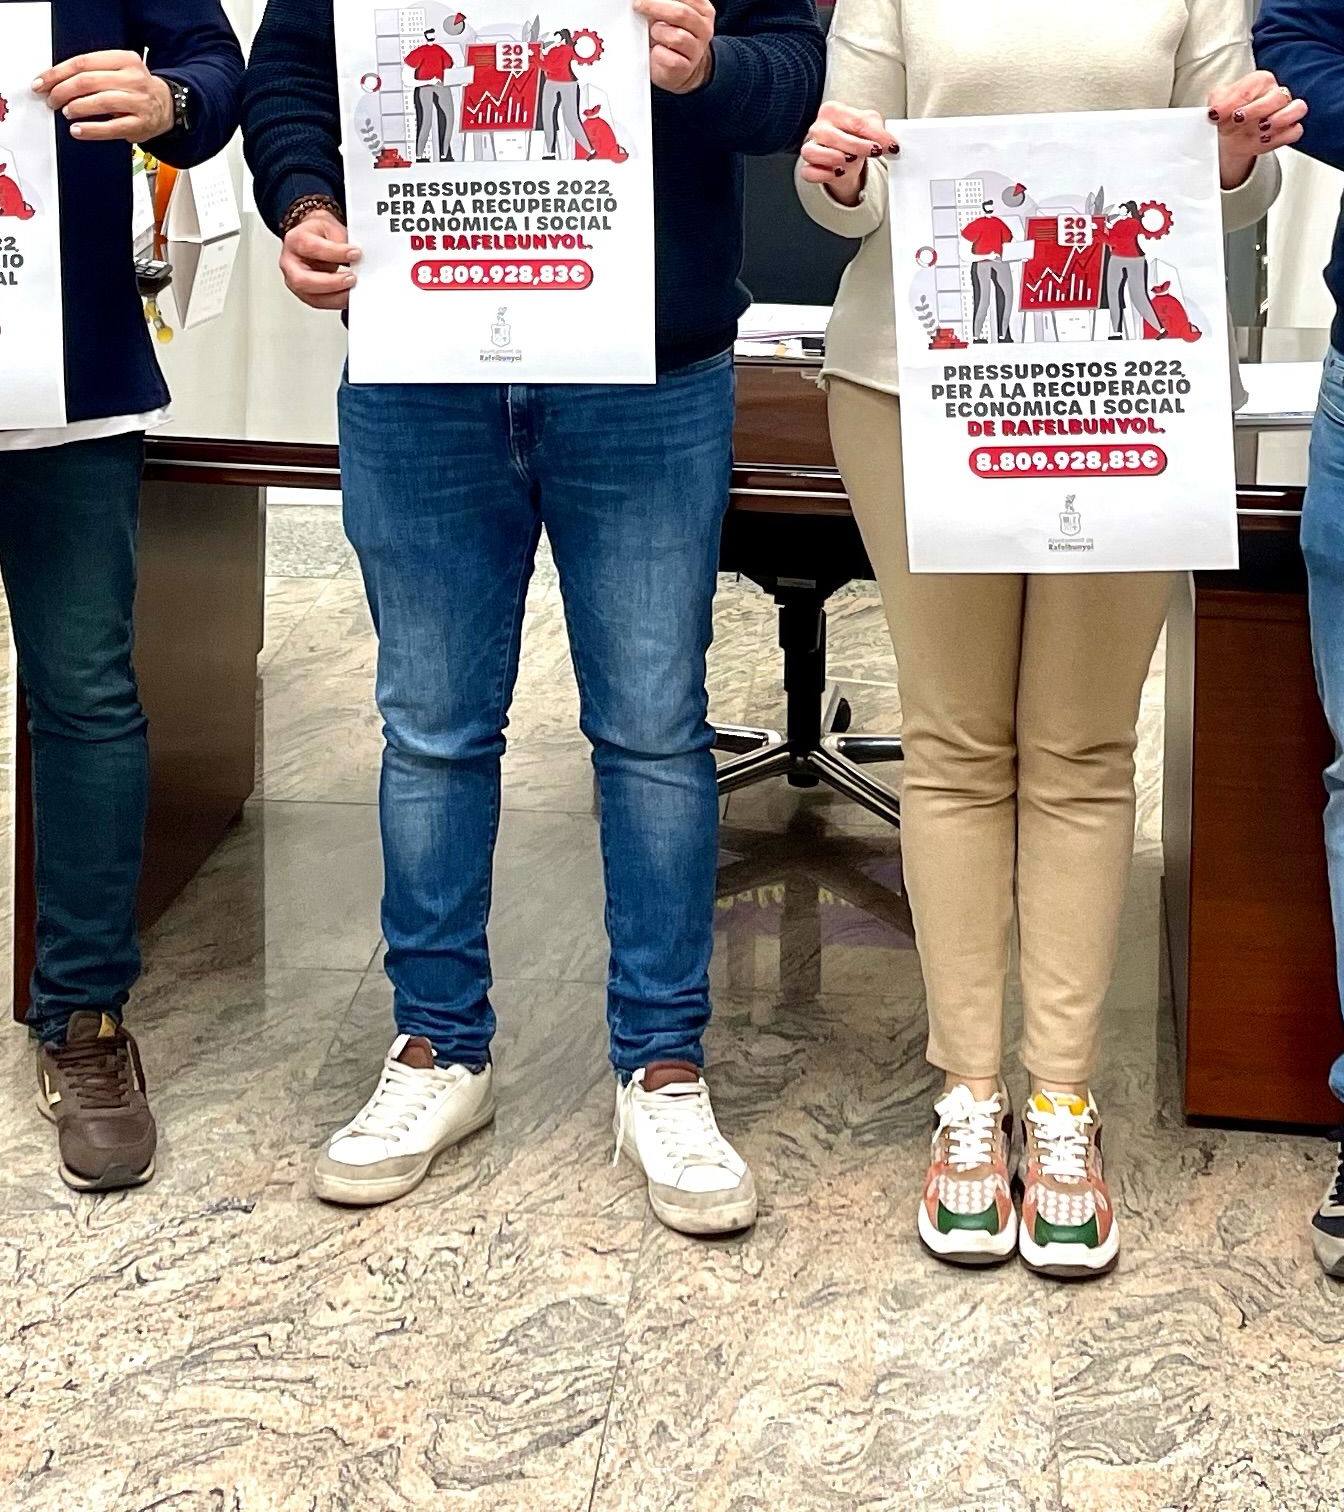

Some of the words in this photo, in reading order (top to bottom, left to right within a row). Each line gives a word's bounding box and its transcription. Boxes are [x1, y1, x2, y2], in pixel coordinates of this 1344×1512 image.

[502, 45, 523, 56] 20
[502, 58, 523, 69] 22
[389, 181, 550, 198] PRESSUPOSTOS
[377, 201, 415, 215] PER
[422, 200, 435, 214] A
[442, 200, 465, 215] LA
[525, 216, 529, 230] I
[537, 216, 611, 230] SOCIAL
[1064, 217, 1086, 230] 20
[411, 235, 436, 250] DE
[443, 234, 593, 250] RAFELBUNYOL.
[1064, 231, 1087, 244] 22
[418, 265, 586, 285] 8.809.928,83€
[944, 362, 1117, 381] PRESSUPOSTOS
[932, 384, 972, 399] PER
[979, 384, 993, 398] A
[1001, 383, 1026, 399] LA
[1090, 400, 1096, 415] I
[1104, 398, 1185, 414] SOCIAL
[968, 420, 995, 437] DE
[1002, 417, 1166, 436] RAFELBUNYOL.
[976, 450, 1158, 471] 8.809.928,83€
